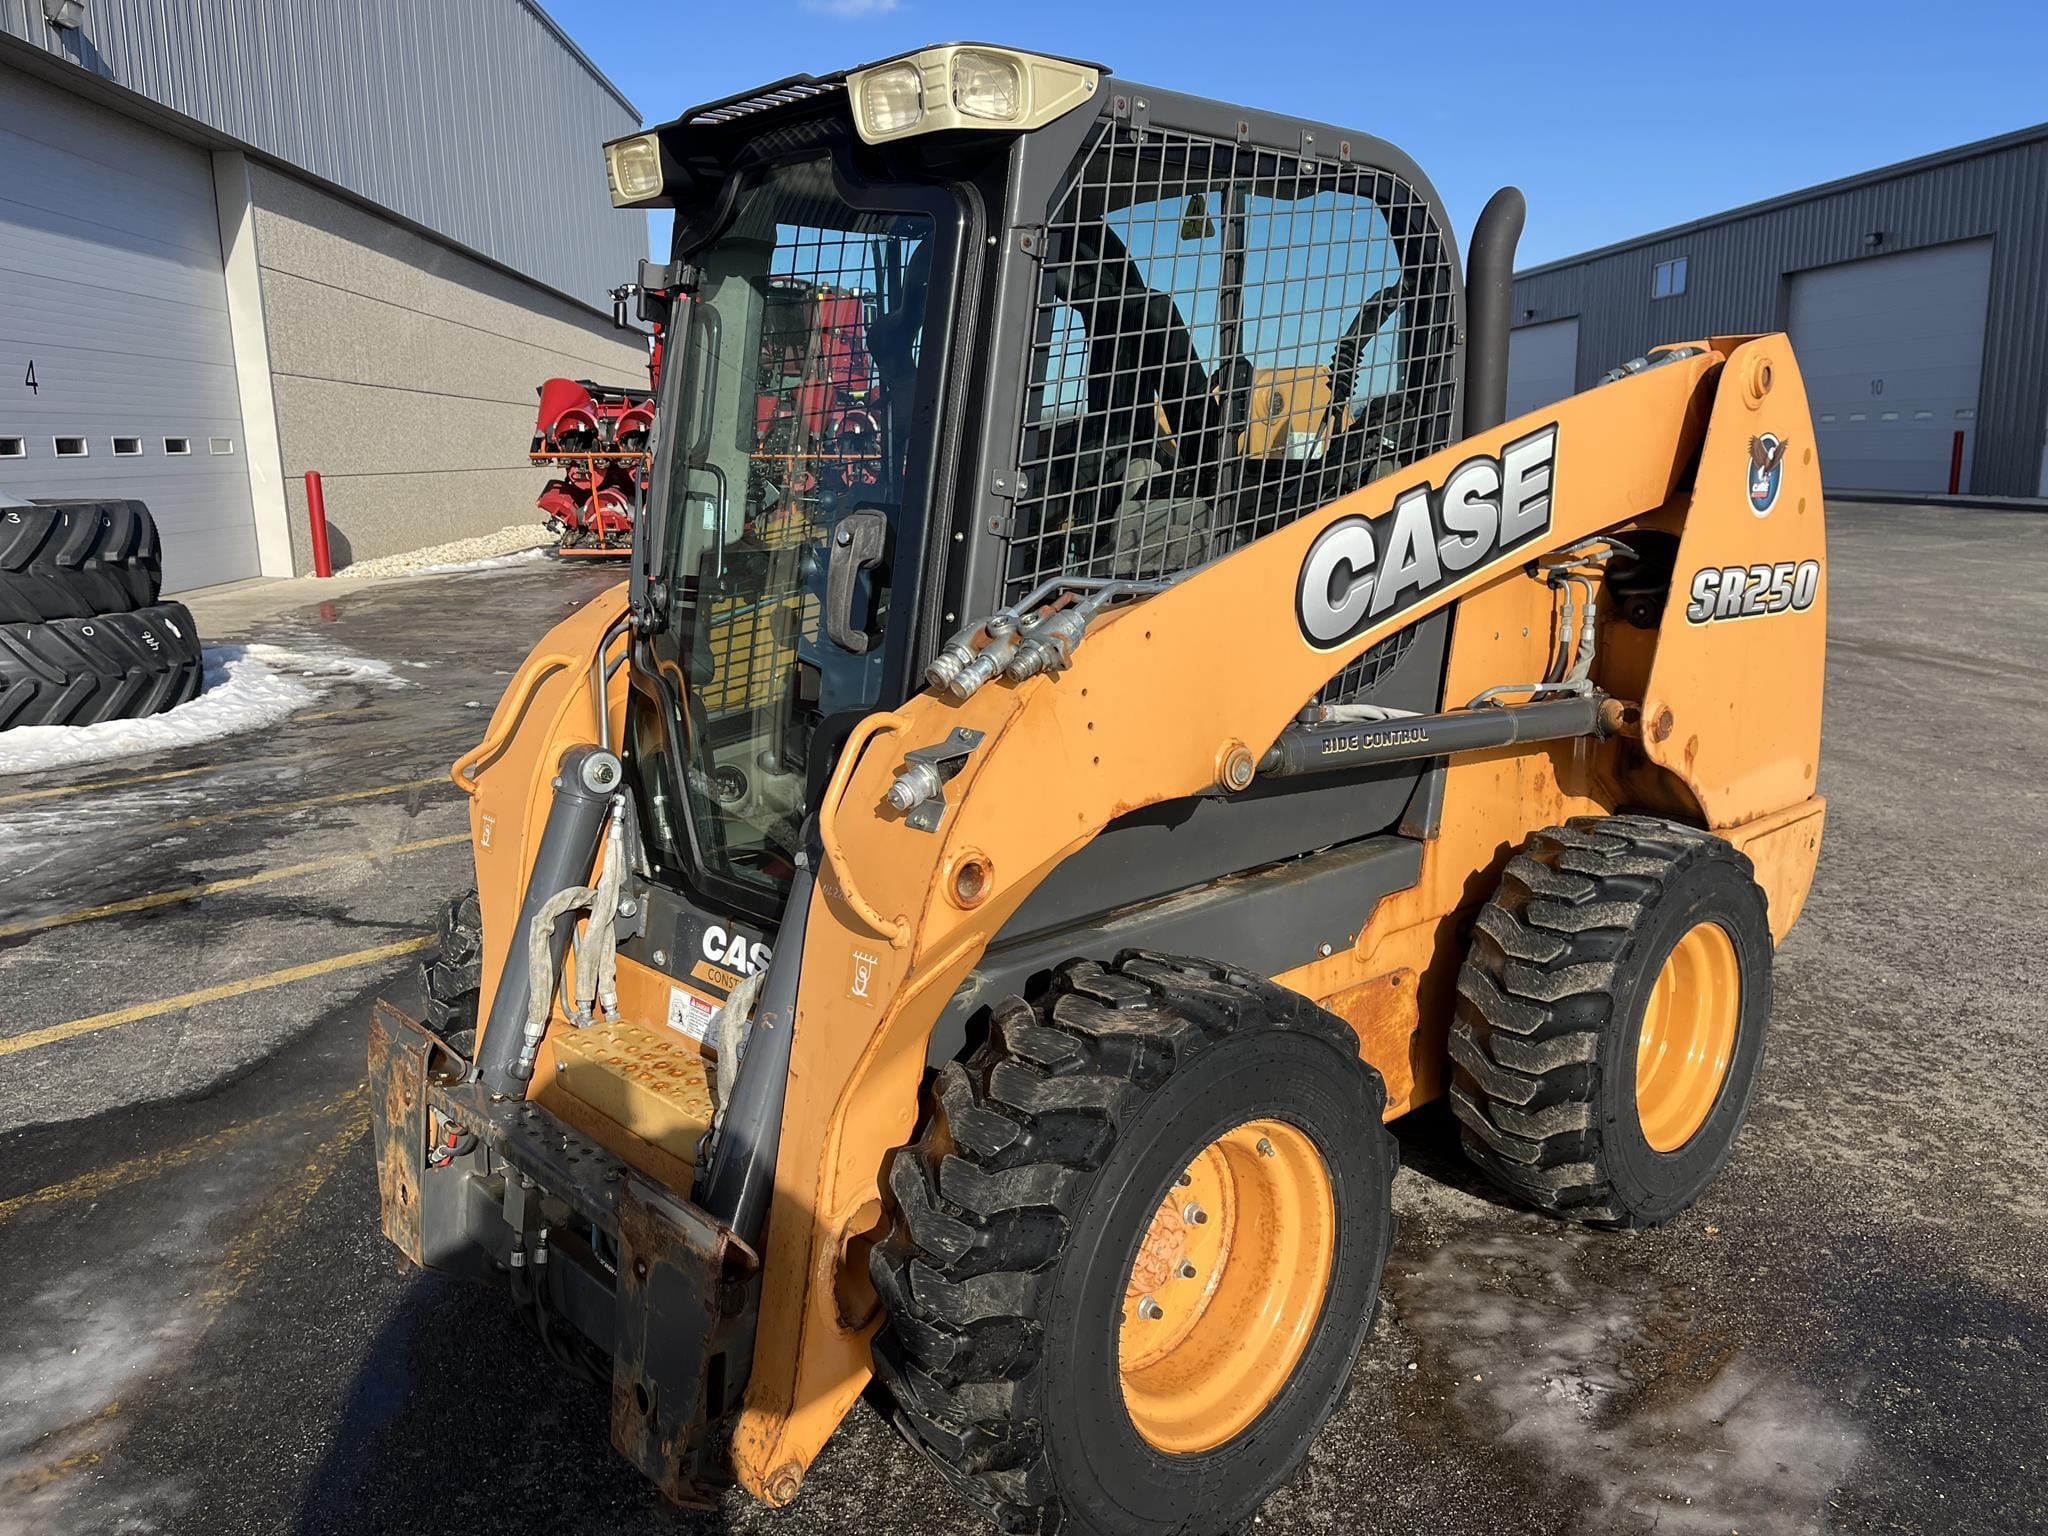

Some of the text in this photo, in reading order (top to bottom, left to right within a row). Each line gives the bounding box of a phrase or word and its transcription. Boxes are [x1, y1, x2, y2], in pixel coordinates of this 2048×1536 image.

[25, 360, 38, 395] 4
[1871, 379, 1884, 395] 10
[8, 513, 21, 523] 3
[1298, 425, 1557, 645] CASE
[1688, 560, 1820, 624] SR250
[1321, 727, 1430, 754] RIDE CONTROL
[702, 925, 772, 975] CAS
[707, 968, 741, 988] CONST
